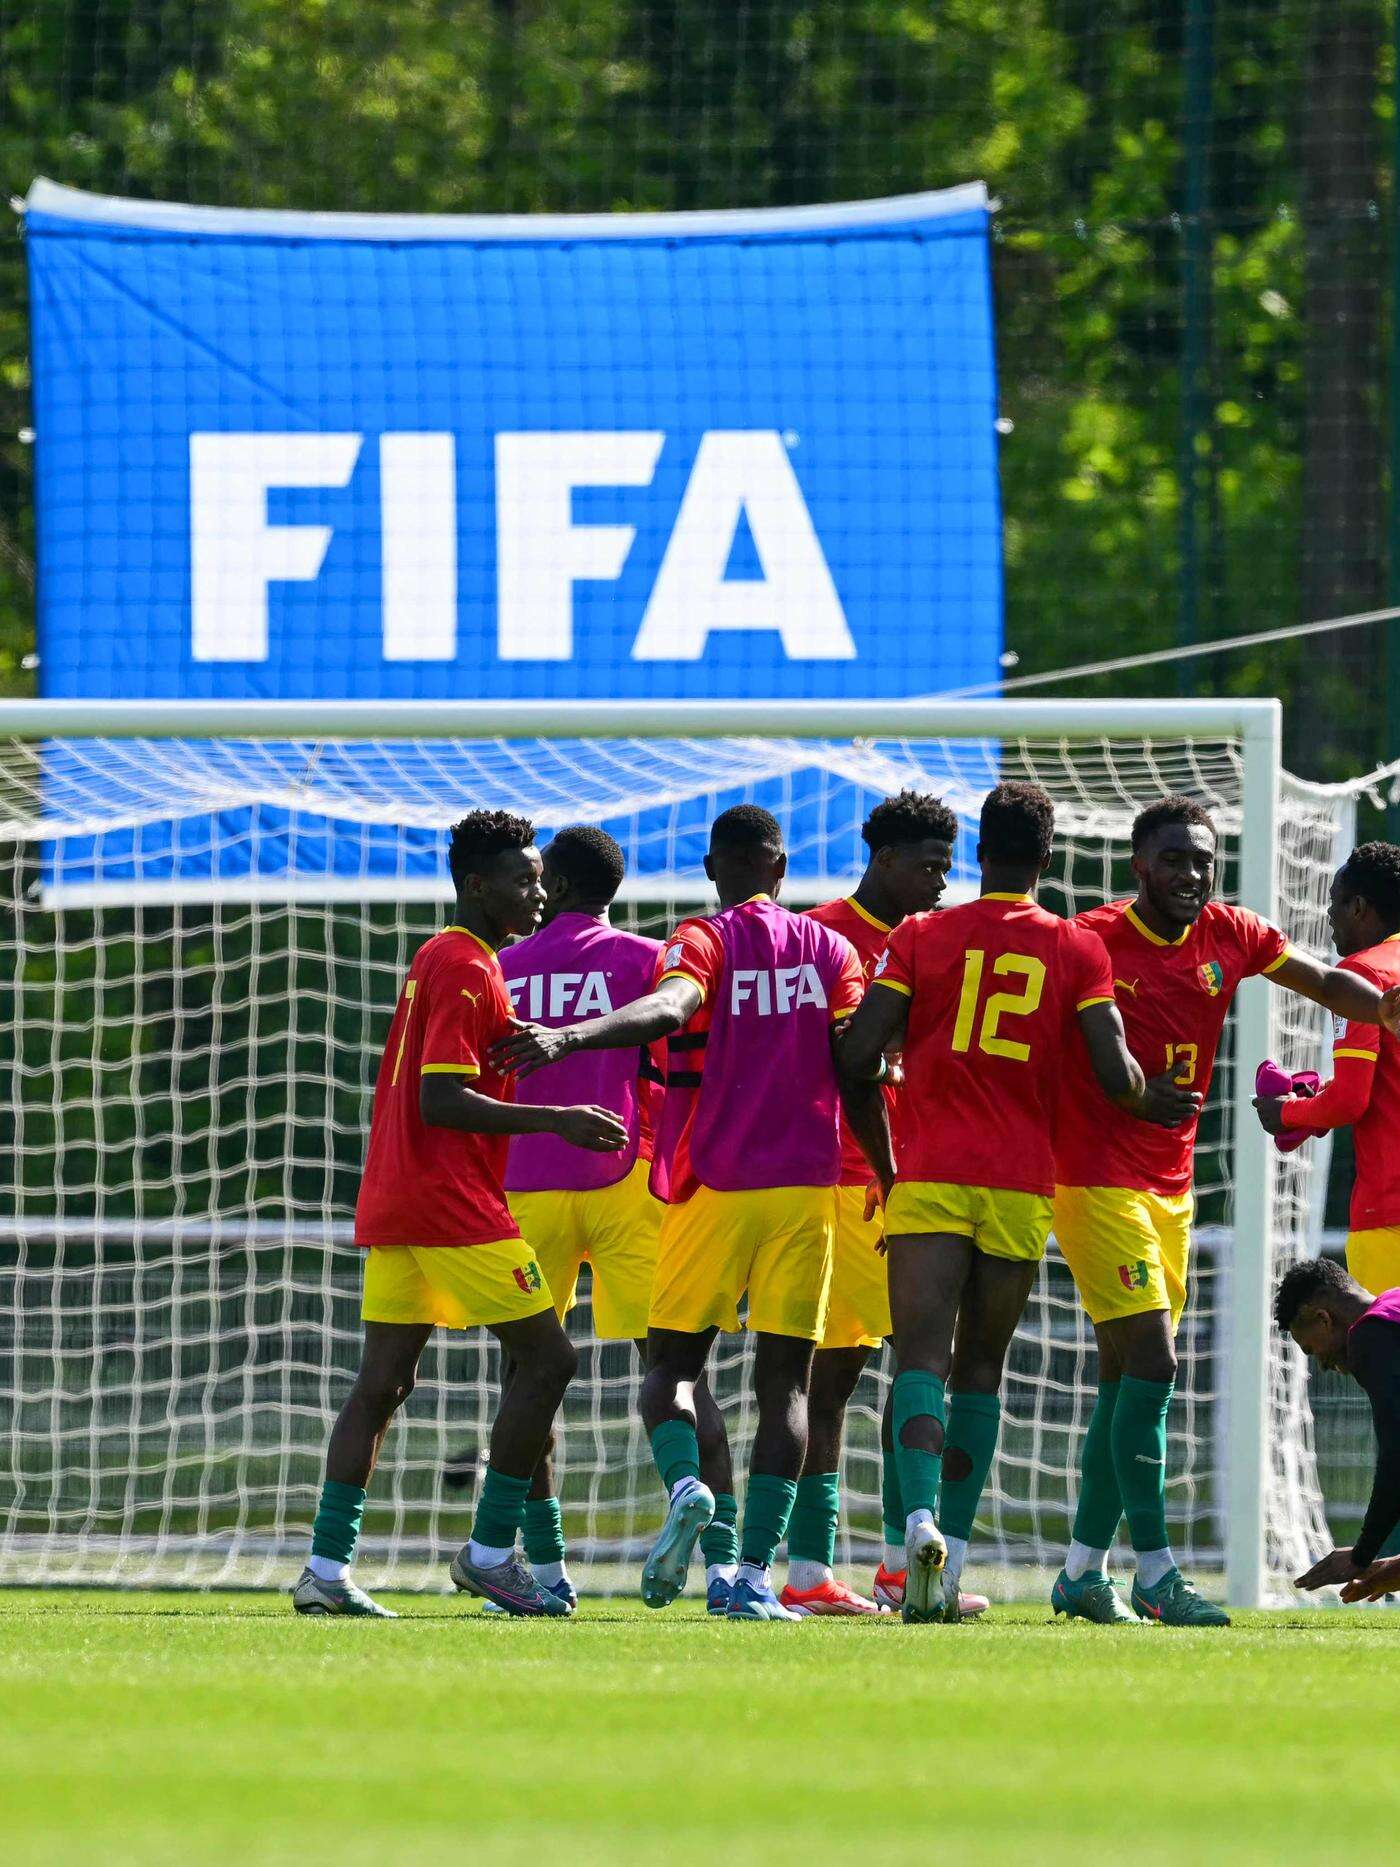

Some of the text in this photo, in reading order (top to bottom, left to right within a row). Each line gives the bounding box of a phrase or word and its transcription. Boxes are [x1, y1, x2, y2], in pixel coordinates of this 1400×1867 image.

[190, 429, 856, 662] FIFA
[731, 963, 828, 1016] FIFA
[952, 949, 1047, 1062] 12
[1165, 1043, 1198, 1085] 13
